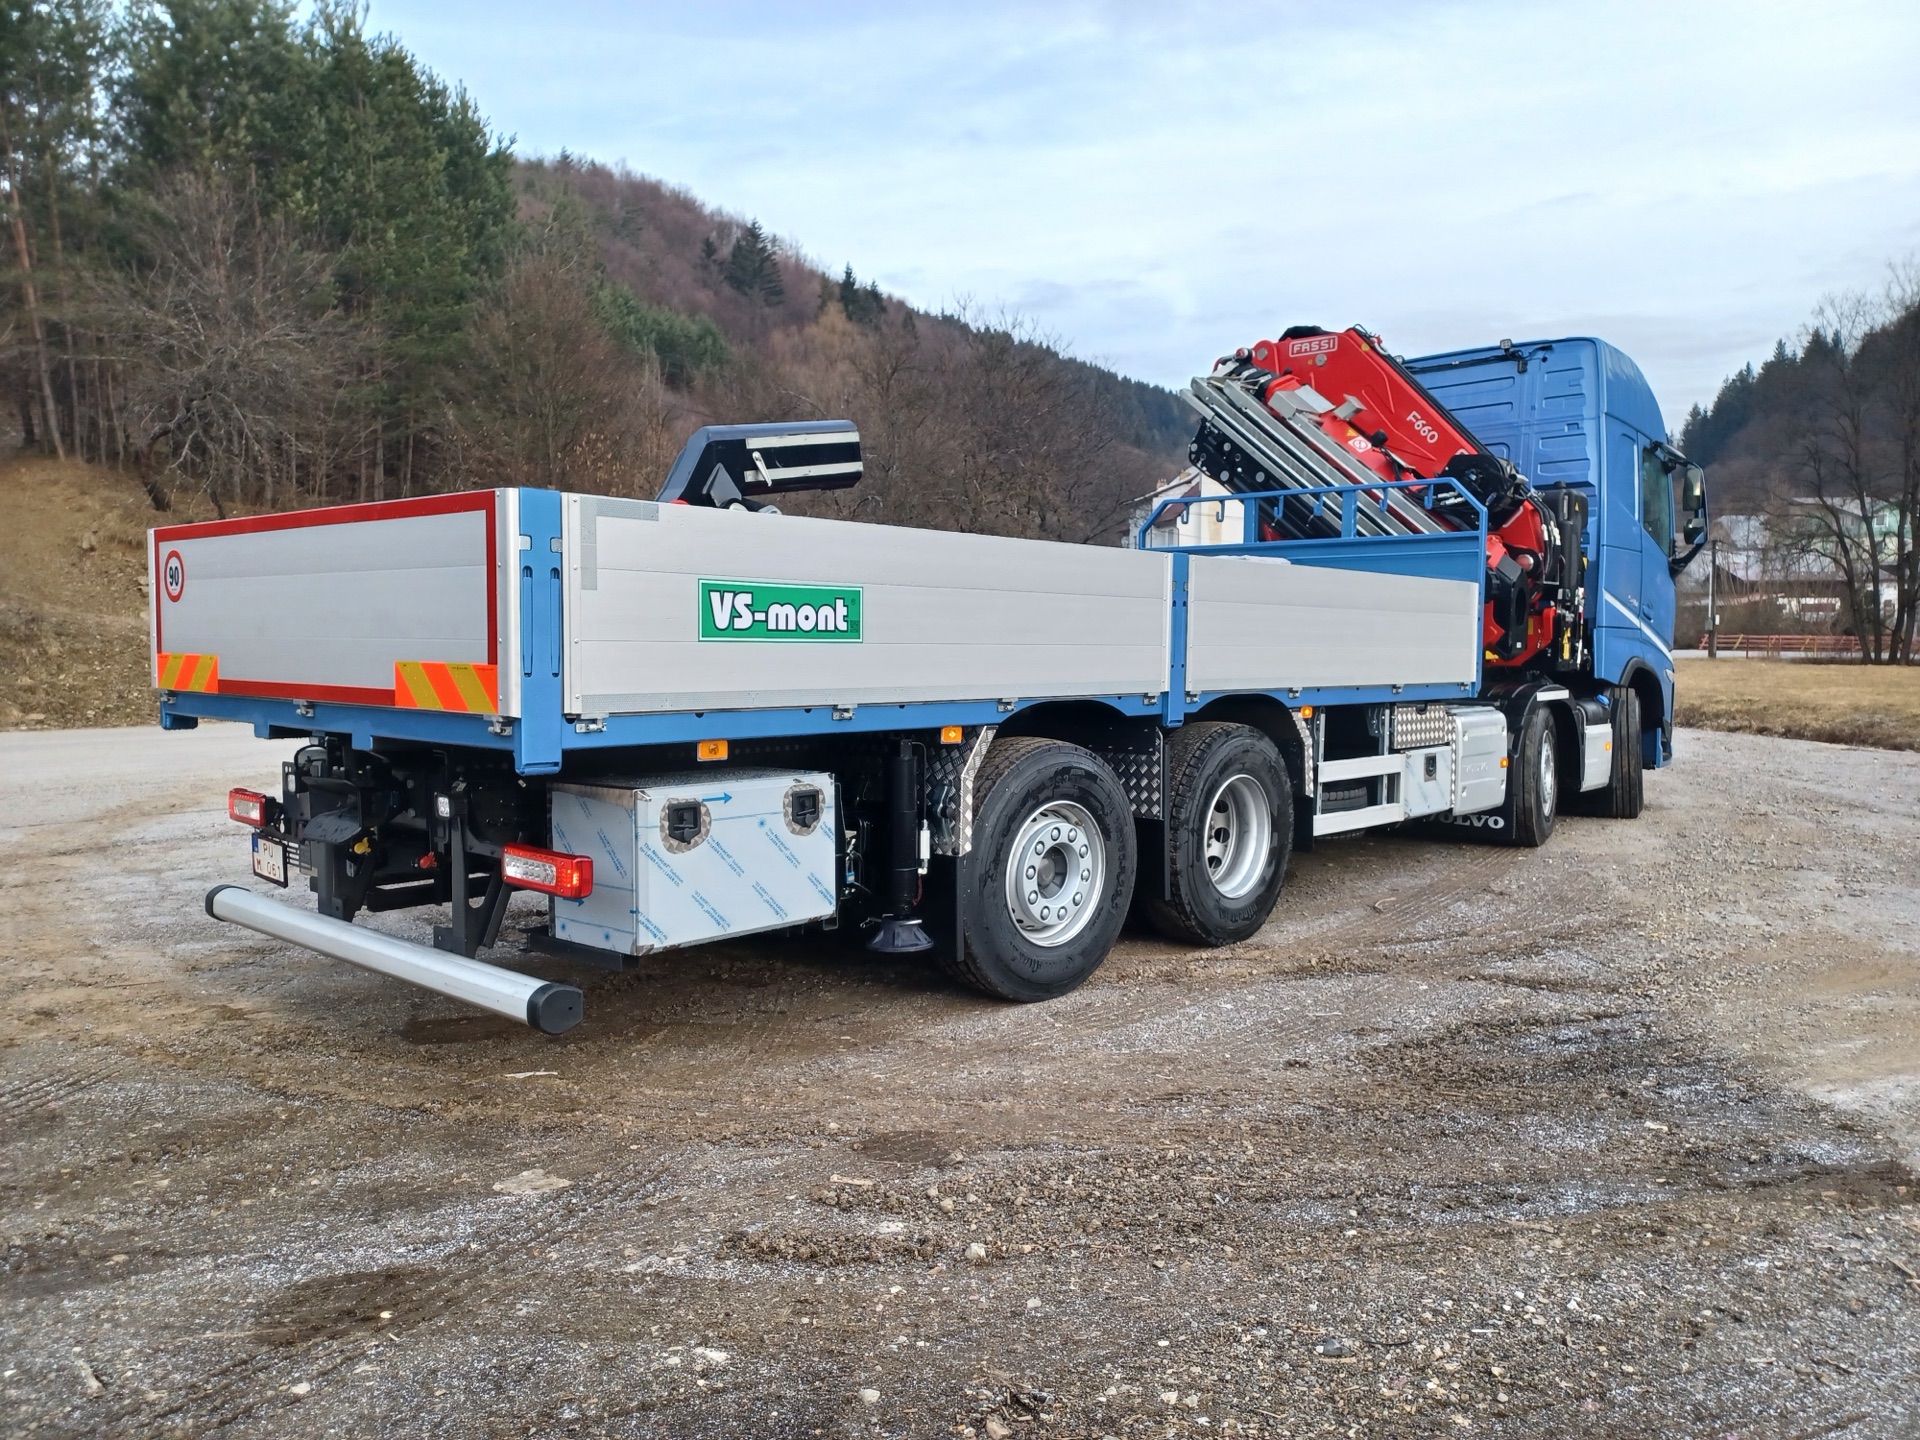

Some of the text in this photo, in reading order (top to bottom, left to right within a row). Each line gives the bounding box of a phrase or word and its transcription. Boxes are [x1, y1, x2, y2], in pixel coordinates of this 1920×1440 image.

[1293, 338, 1335, 354] FASSI
[1406, 410, 1439, 444] F660
[169, 565, 179, 587] 90
[708, 590, 848, 632] VS-mont
[1429, 812, 1505, 829] OLVO
[263, 842, 273, 858] PU
